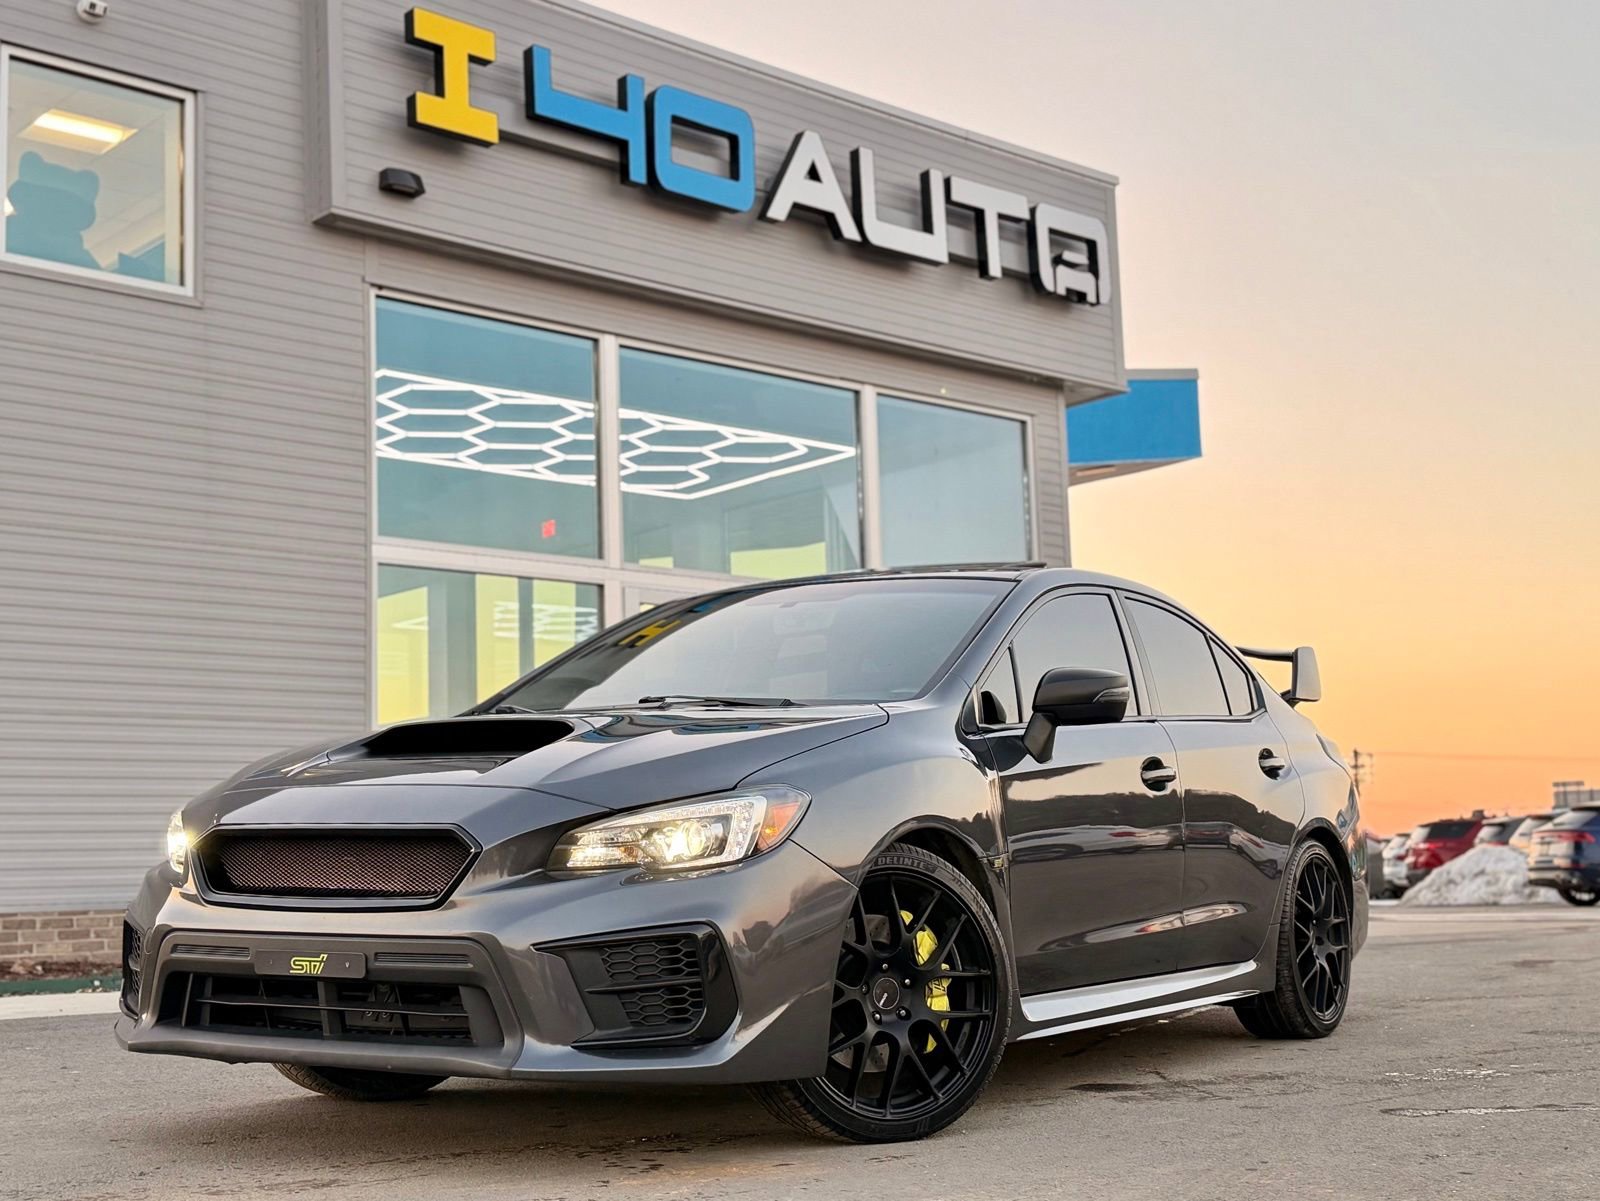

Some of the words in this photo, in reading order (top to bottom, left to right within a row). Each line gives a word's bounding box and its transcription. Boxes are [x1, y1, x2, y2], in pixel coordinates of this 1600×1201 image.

[405, 7, 500, 146] I
[525, 44, 755, 212] 40
[877, 856, 927, 870] DELINTE
